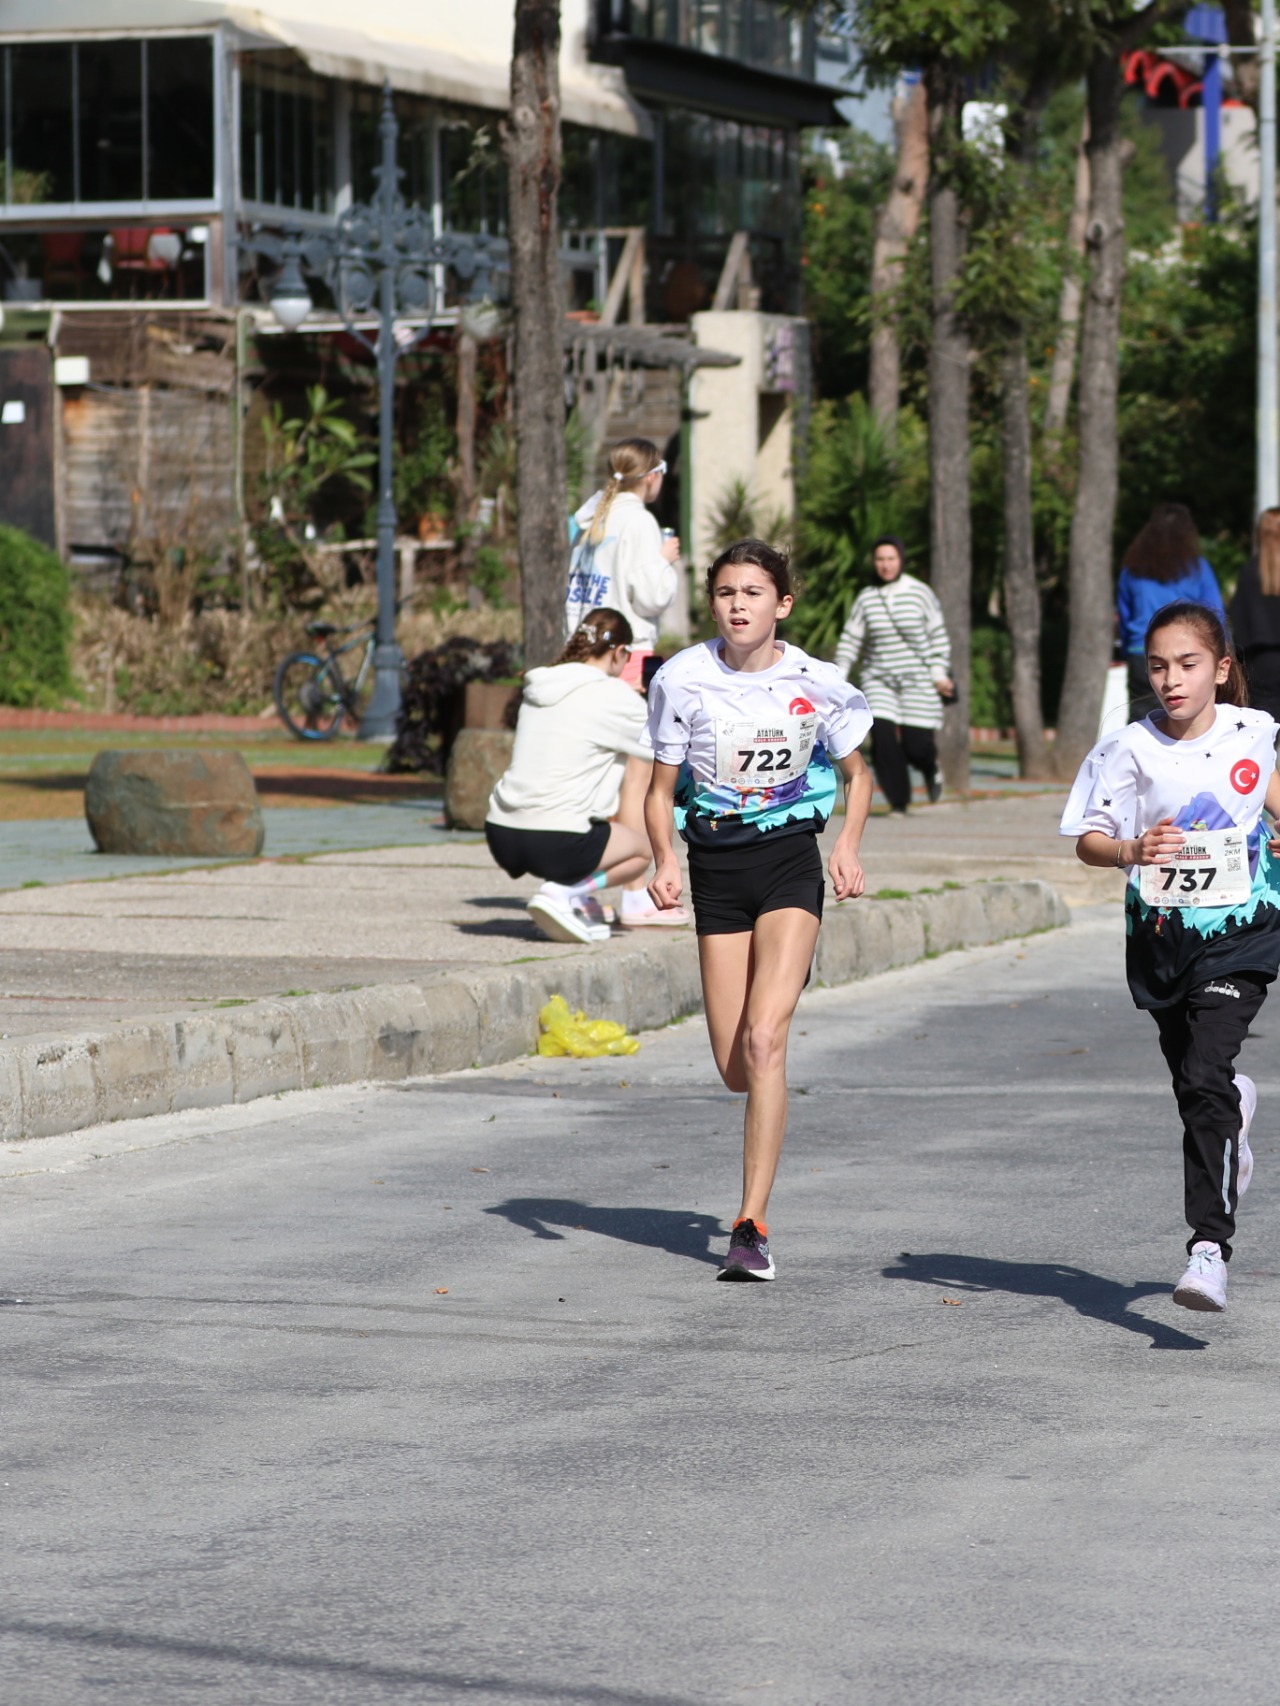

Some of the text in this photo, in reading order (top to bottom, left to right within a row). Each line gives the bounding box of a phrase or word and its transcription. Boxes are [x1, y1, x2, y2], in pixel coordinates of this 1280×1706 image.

[757, 728, 784, 738] ATATÜRK
[738, 748, 792, 772] 722
[1224, 848, 1241, 857] 2KM
[1160, 867, 1217, 892] 737
